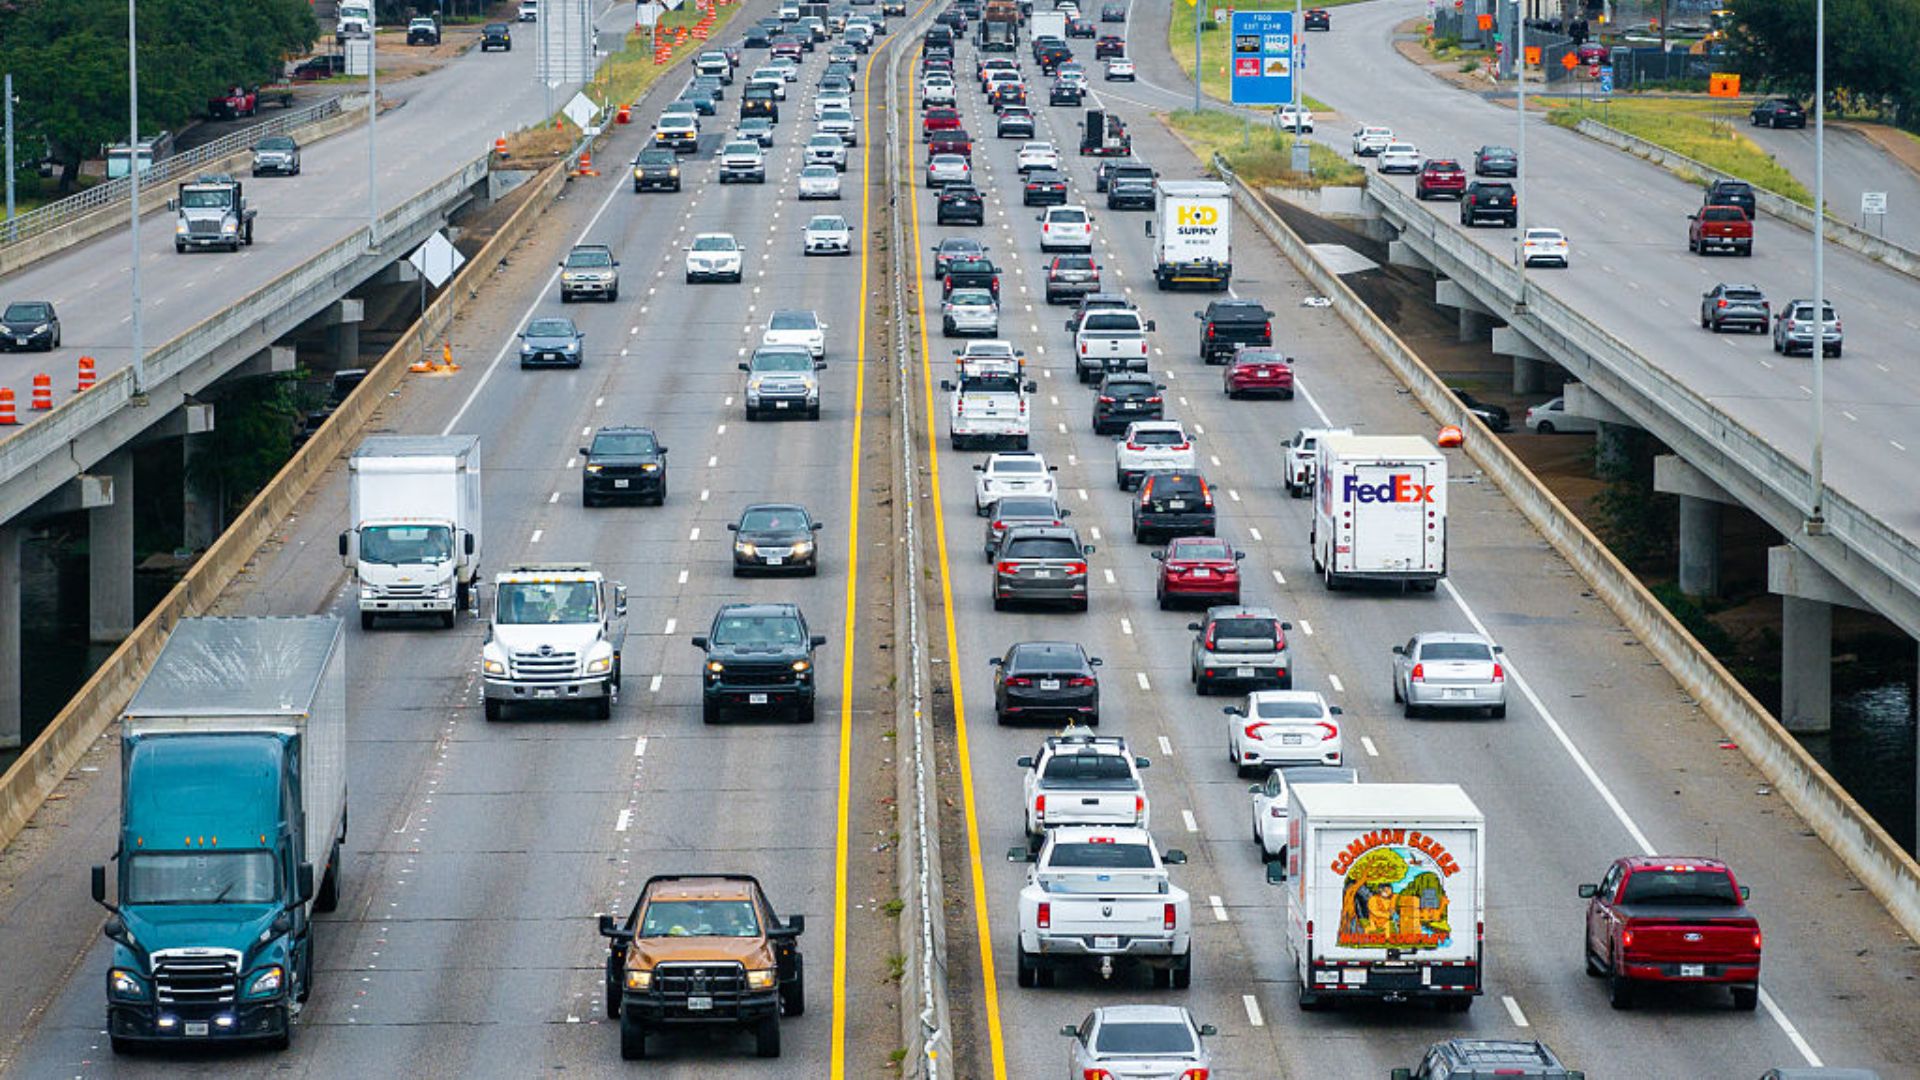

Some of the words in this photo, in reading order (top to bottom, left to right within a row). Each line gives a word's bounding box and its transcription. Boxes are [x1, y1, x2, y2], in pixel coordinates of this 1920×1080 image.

[1177, 205, 1219, 225] HD
[1177, 227, 1218, 235] SUPPLY
[1343, 474, 1435, 503] FedEx
[1331, 828, 1406, 876] COMMON
[1408, 831, 1461, 878] SENSE
[1389, 932, 1447, 944] COMPANY
